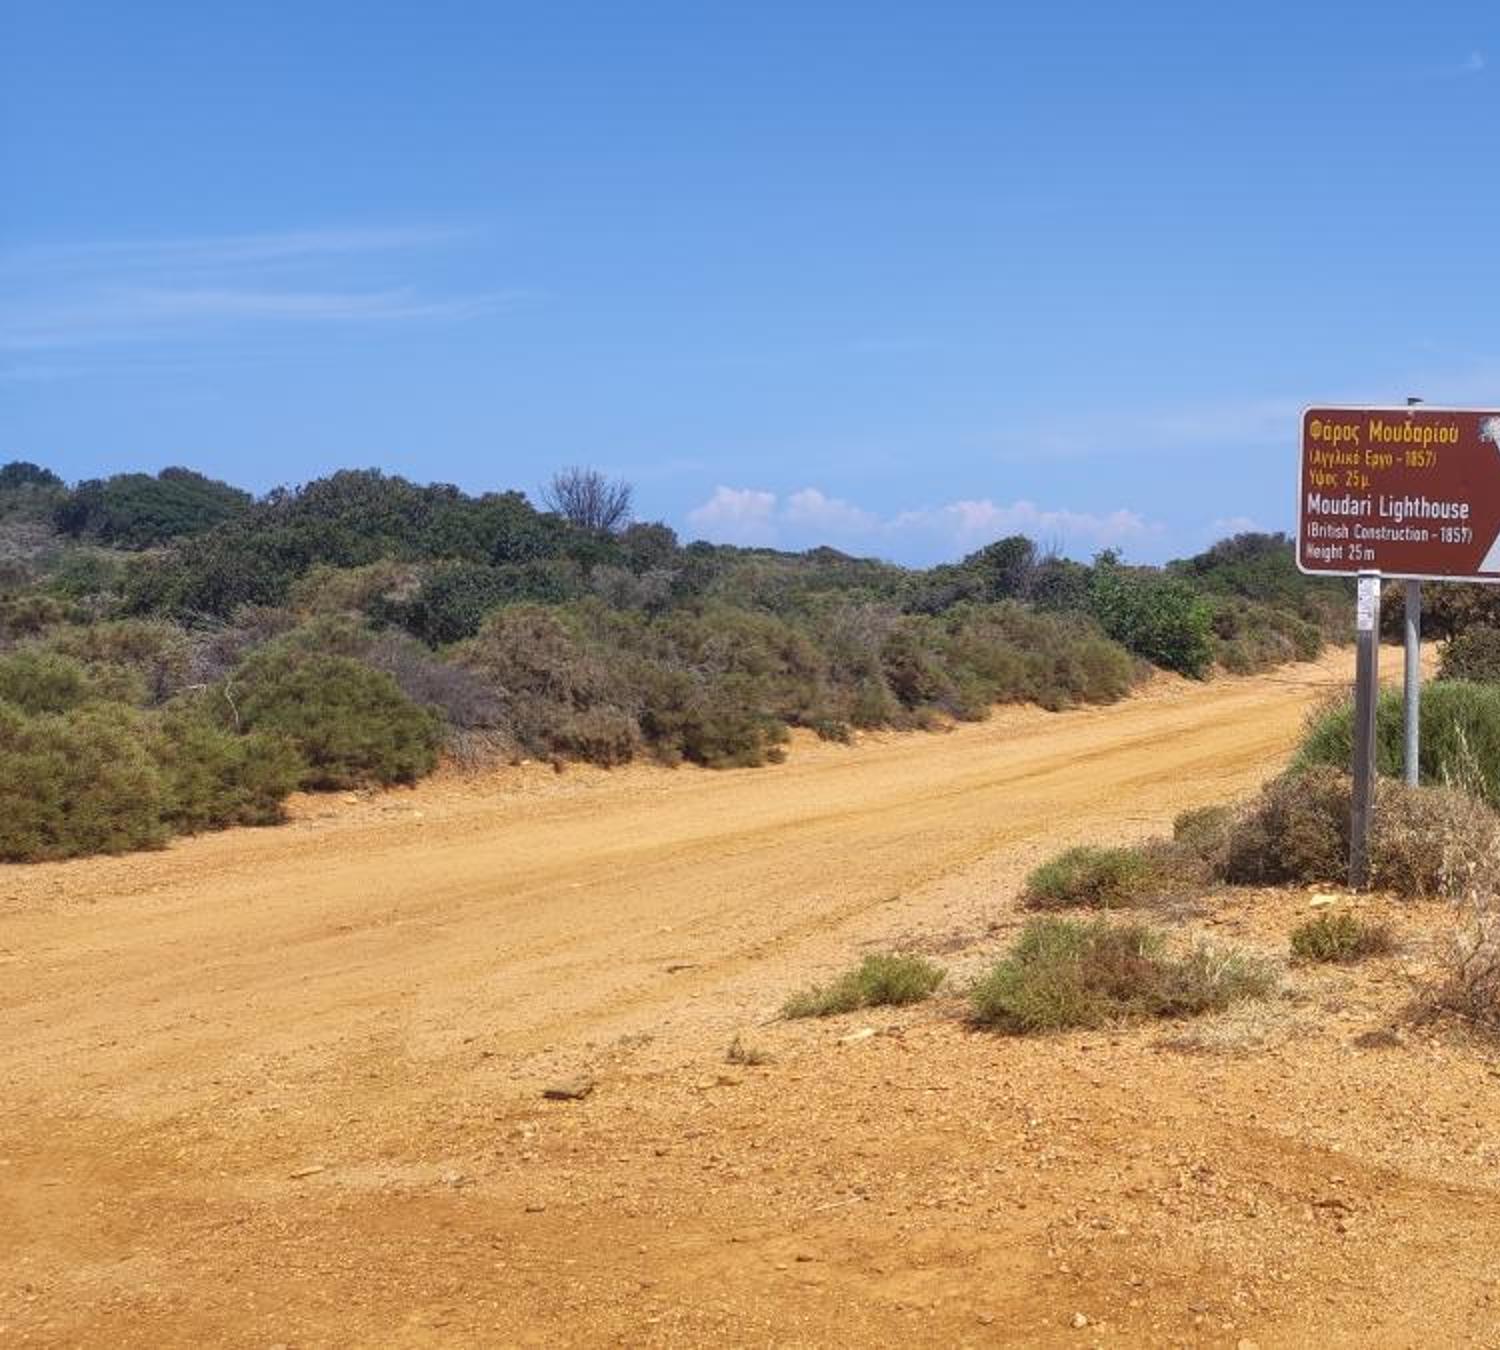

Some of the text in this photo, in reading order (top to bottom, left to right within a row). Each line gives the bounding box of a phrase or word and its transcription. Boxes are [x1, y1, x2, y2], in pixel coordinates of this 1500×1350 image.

[1405, 449, 1437, 468] 1857)
[1307, 492, 1469, 523] Moudari Lighthouse
[1307, 521, 1349, 539] (British
[1354, 523, 1429, 541] Construction
[1440, 526, 1473, 544] 1857)
[1306, 543, 1343, 563] Height
